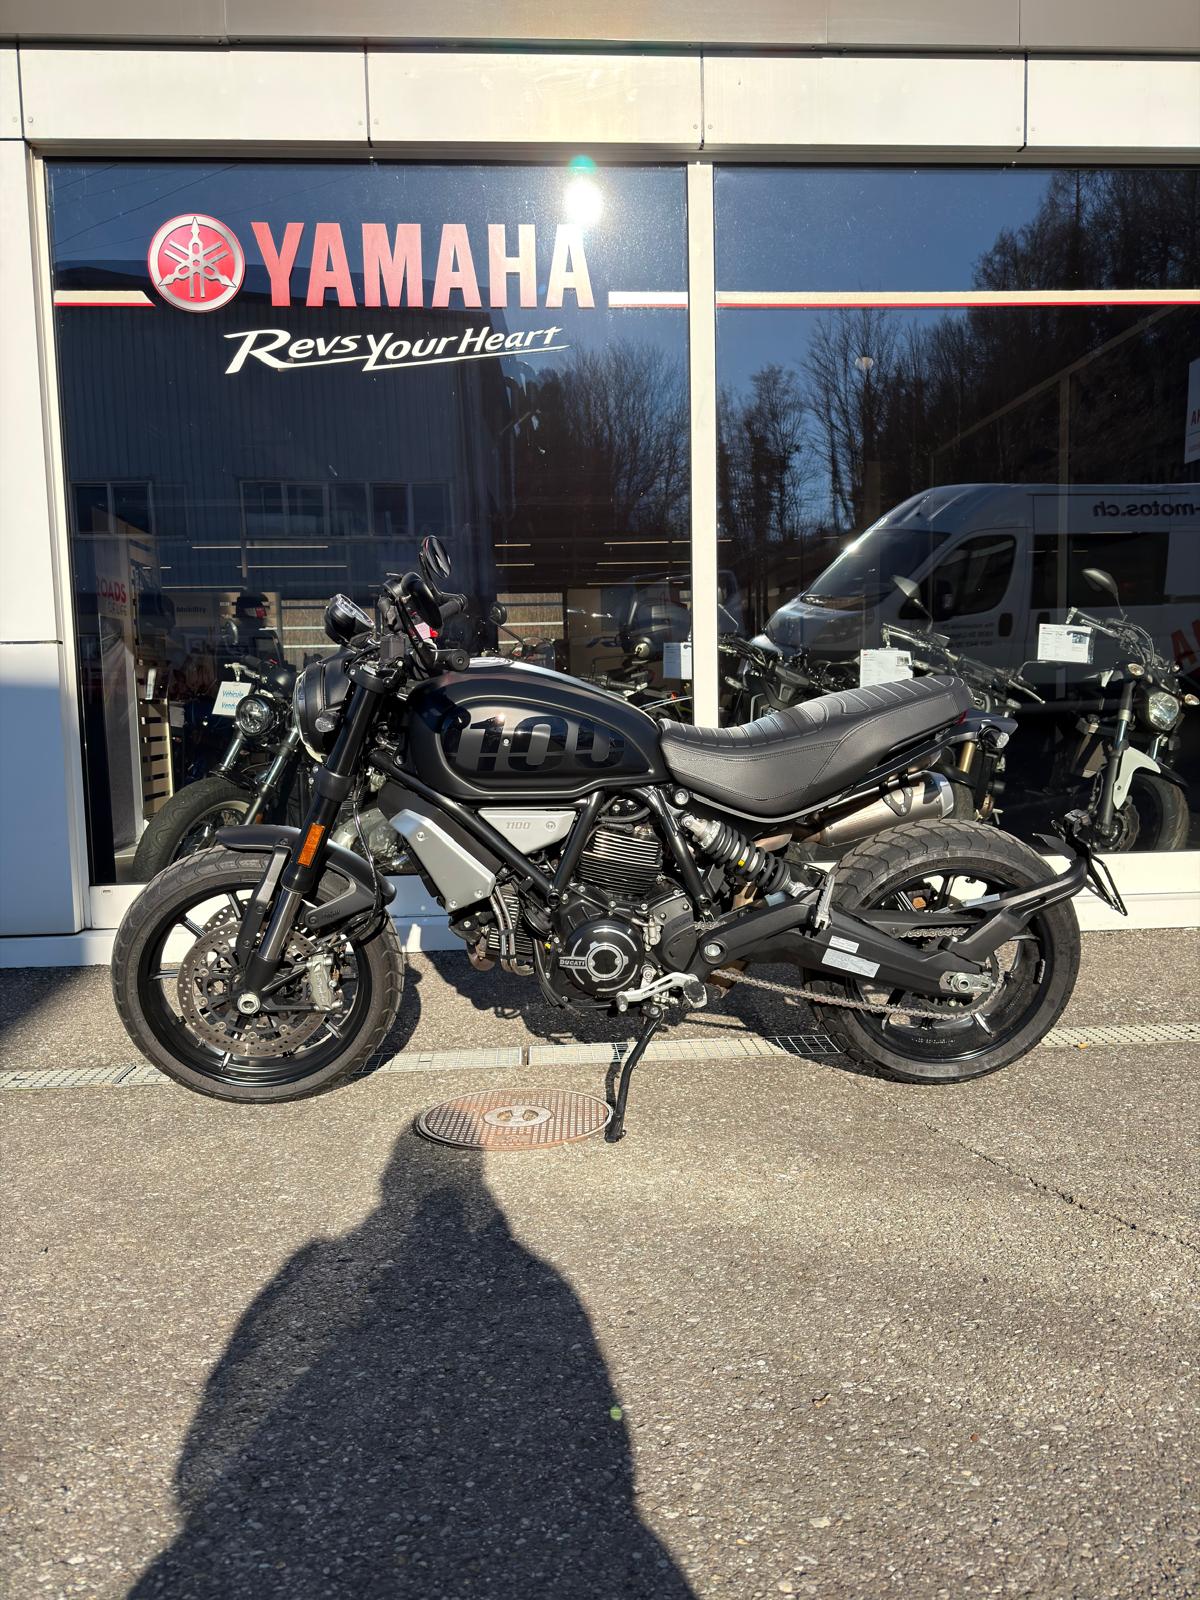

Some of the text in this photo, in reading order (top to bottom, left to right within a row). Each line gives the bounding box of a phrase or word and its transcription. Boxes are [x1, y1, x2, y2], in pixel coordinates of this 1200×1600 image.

[251, 222, 595, 308] YAMAHA
[224, 325, 564, 374] Revs Your Heart
[505, 821, 531, 830] 1100
